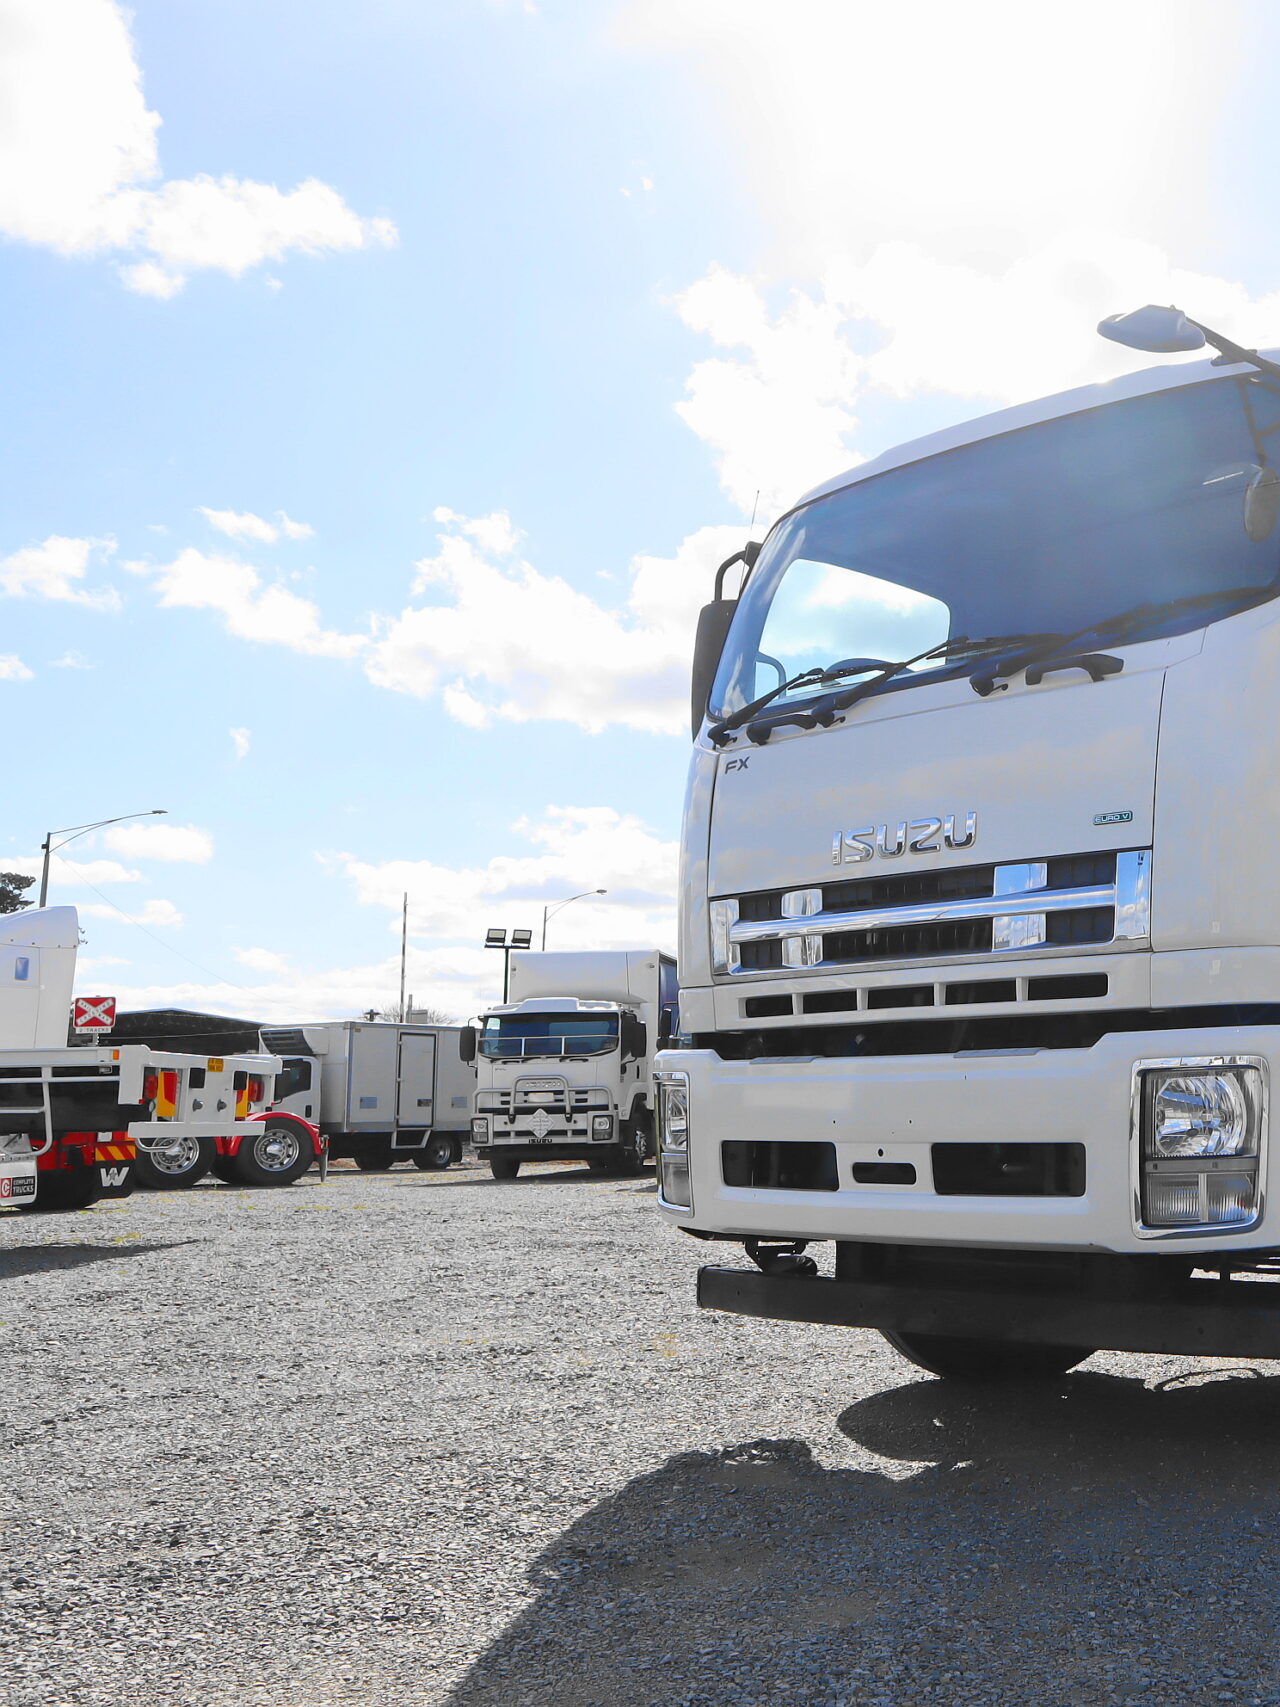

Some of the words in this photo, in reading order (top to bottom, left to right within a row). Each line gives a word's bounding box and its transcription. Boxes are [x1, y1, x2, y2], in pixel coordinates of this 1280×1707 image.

[725, 756, 750, 774] FX
[1095, 814, 1120, 822] EURO
[831, 811, 977, 866] ISUZU
[13, 1185, 34, 1195] TRUCKS
